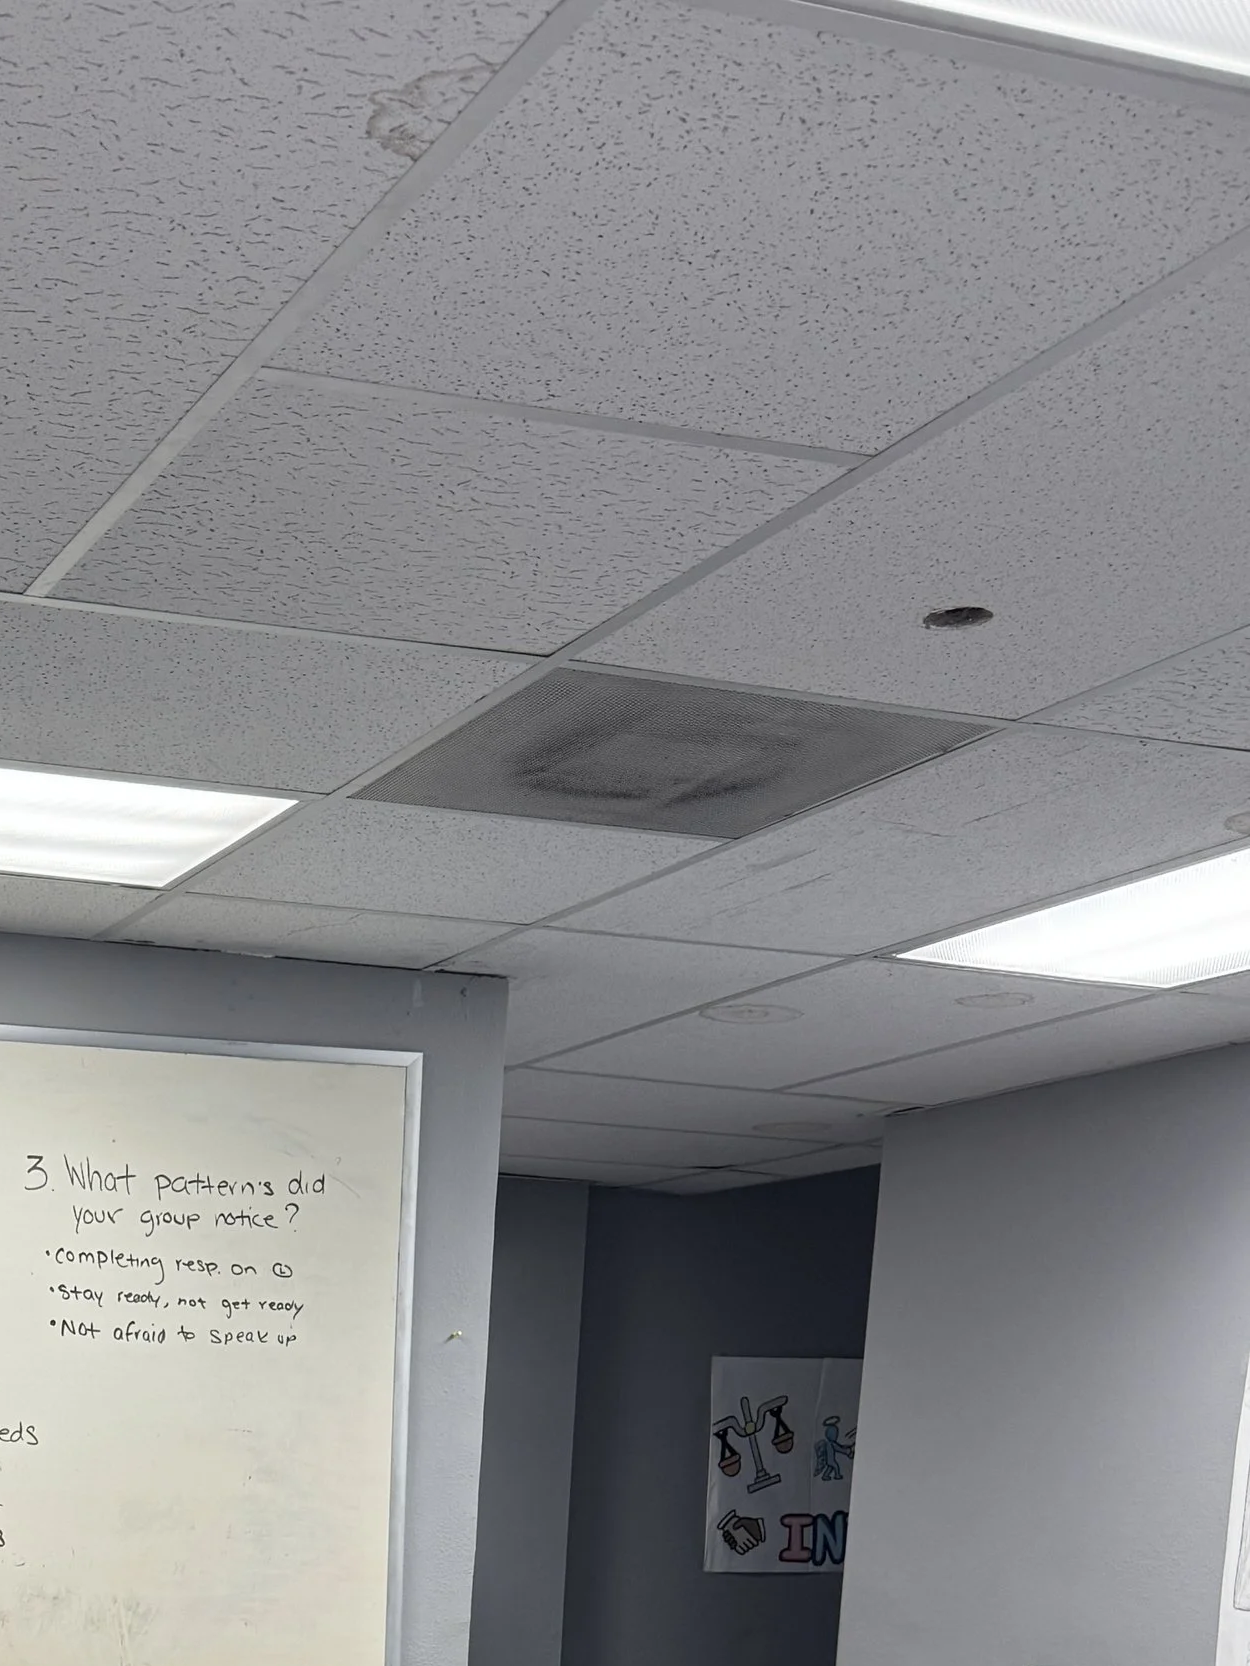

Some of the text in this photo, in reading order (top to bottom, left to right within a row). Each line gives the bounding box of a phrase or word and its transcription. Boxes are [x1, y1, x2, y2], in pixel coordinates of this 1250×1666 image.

[24, 1154, 325, 1200] 3. What pattern's did
[72, 1204, 123, 1233] your
[140, 1210, 200, 1237] group
[231, 1264, 257, 1275] on
[118, 1291, 169, 1309] ready,
[178, 1297, 206, 1308] not
[222, 1298, 250, 1319] get
[259, 1301, 304, 1320] ready
[61, 1319, 101, 1338] Not
[114, 1322, 166, 1343] afraid
[178, 1326, 195, 1342] to
[277, 1333, 297, 1346] up
